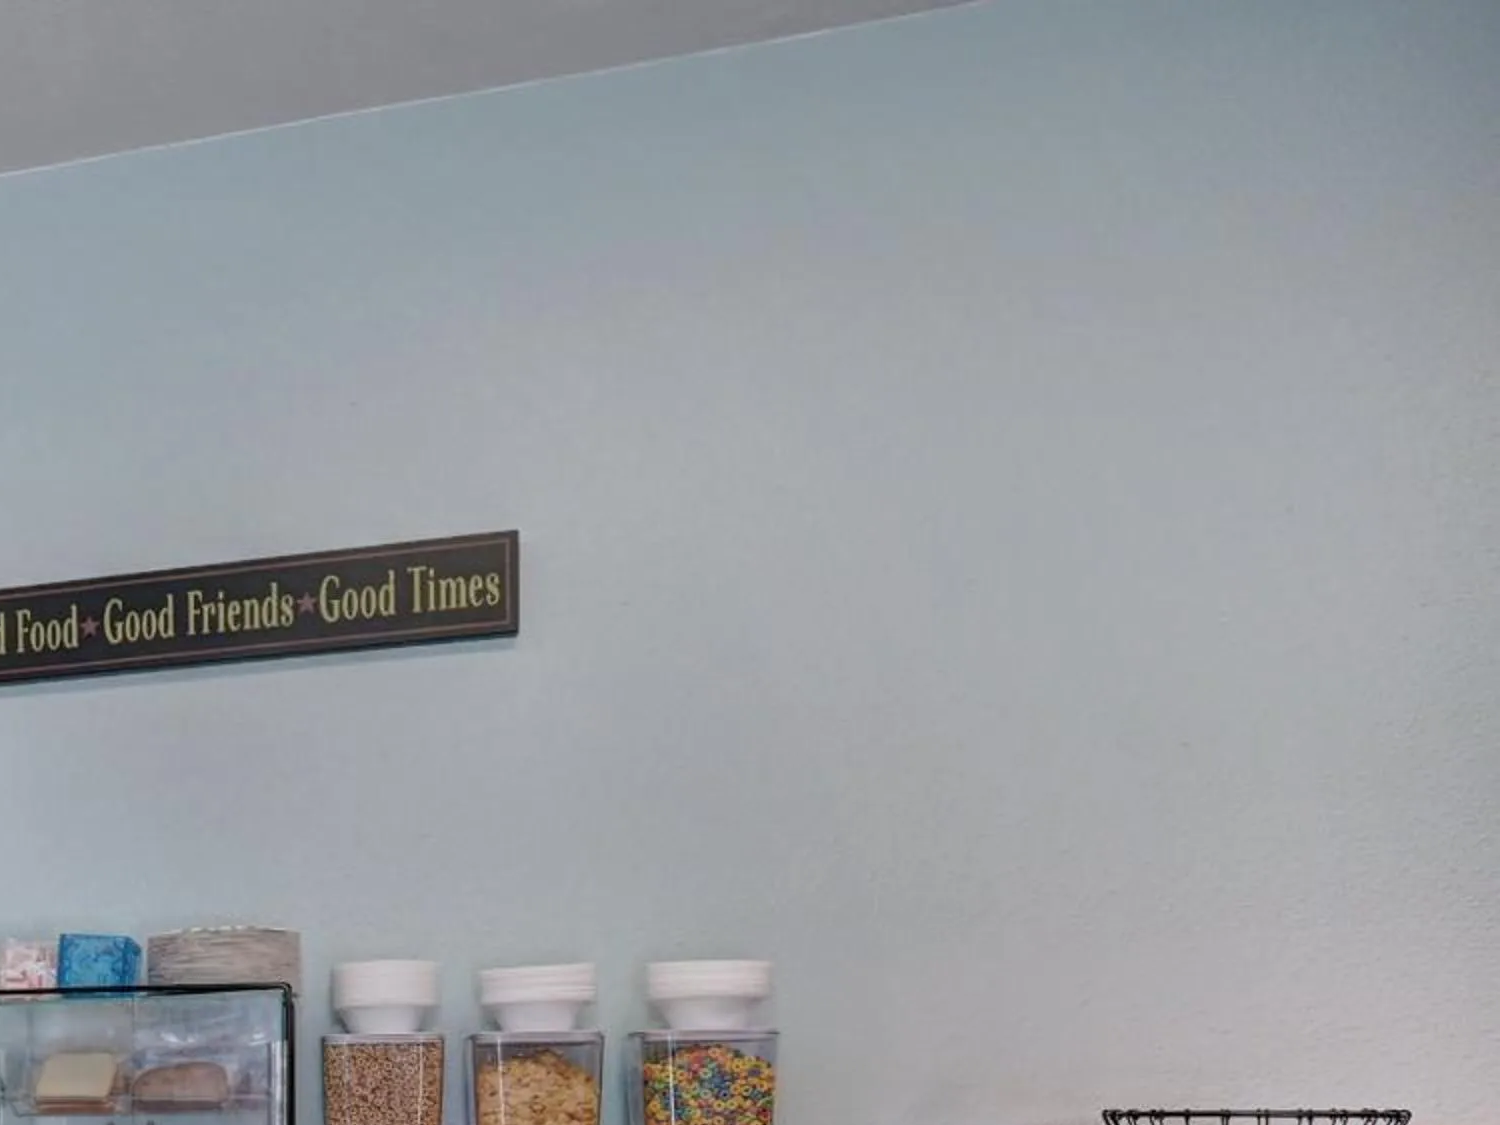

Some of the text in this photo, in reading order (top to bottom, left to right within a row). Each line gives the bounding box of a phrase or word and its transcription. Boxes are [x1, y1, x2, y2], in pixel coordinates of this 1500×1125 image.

[16, 604, 79, 653] Food
[103, 594, 175, 645] Good
[187, 582, 295, 636] Friends
[319, 570, 397, 624] Good
[407, 565, 500, 614] Times
